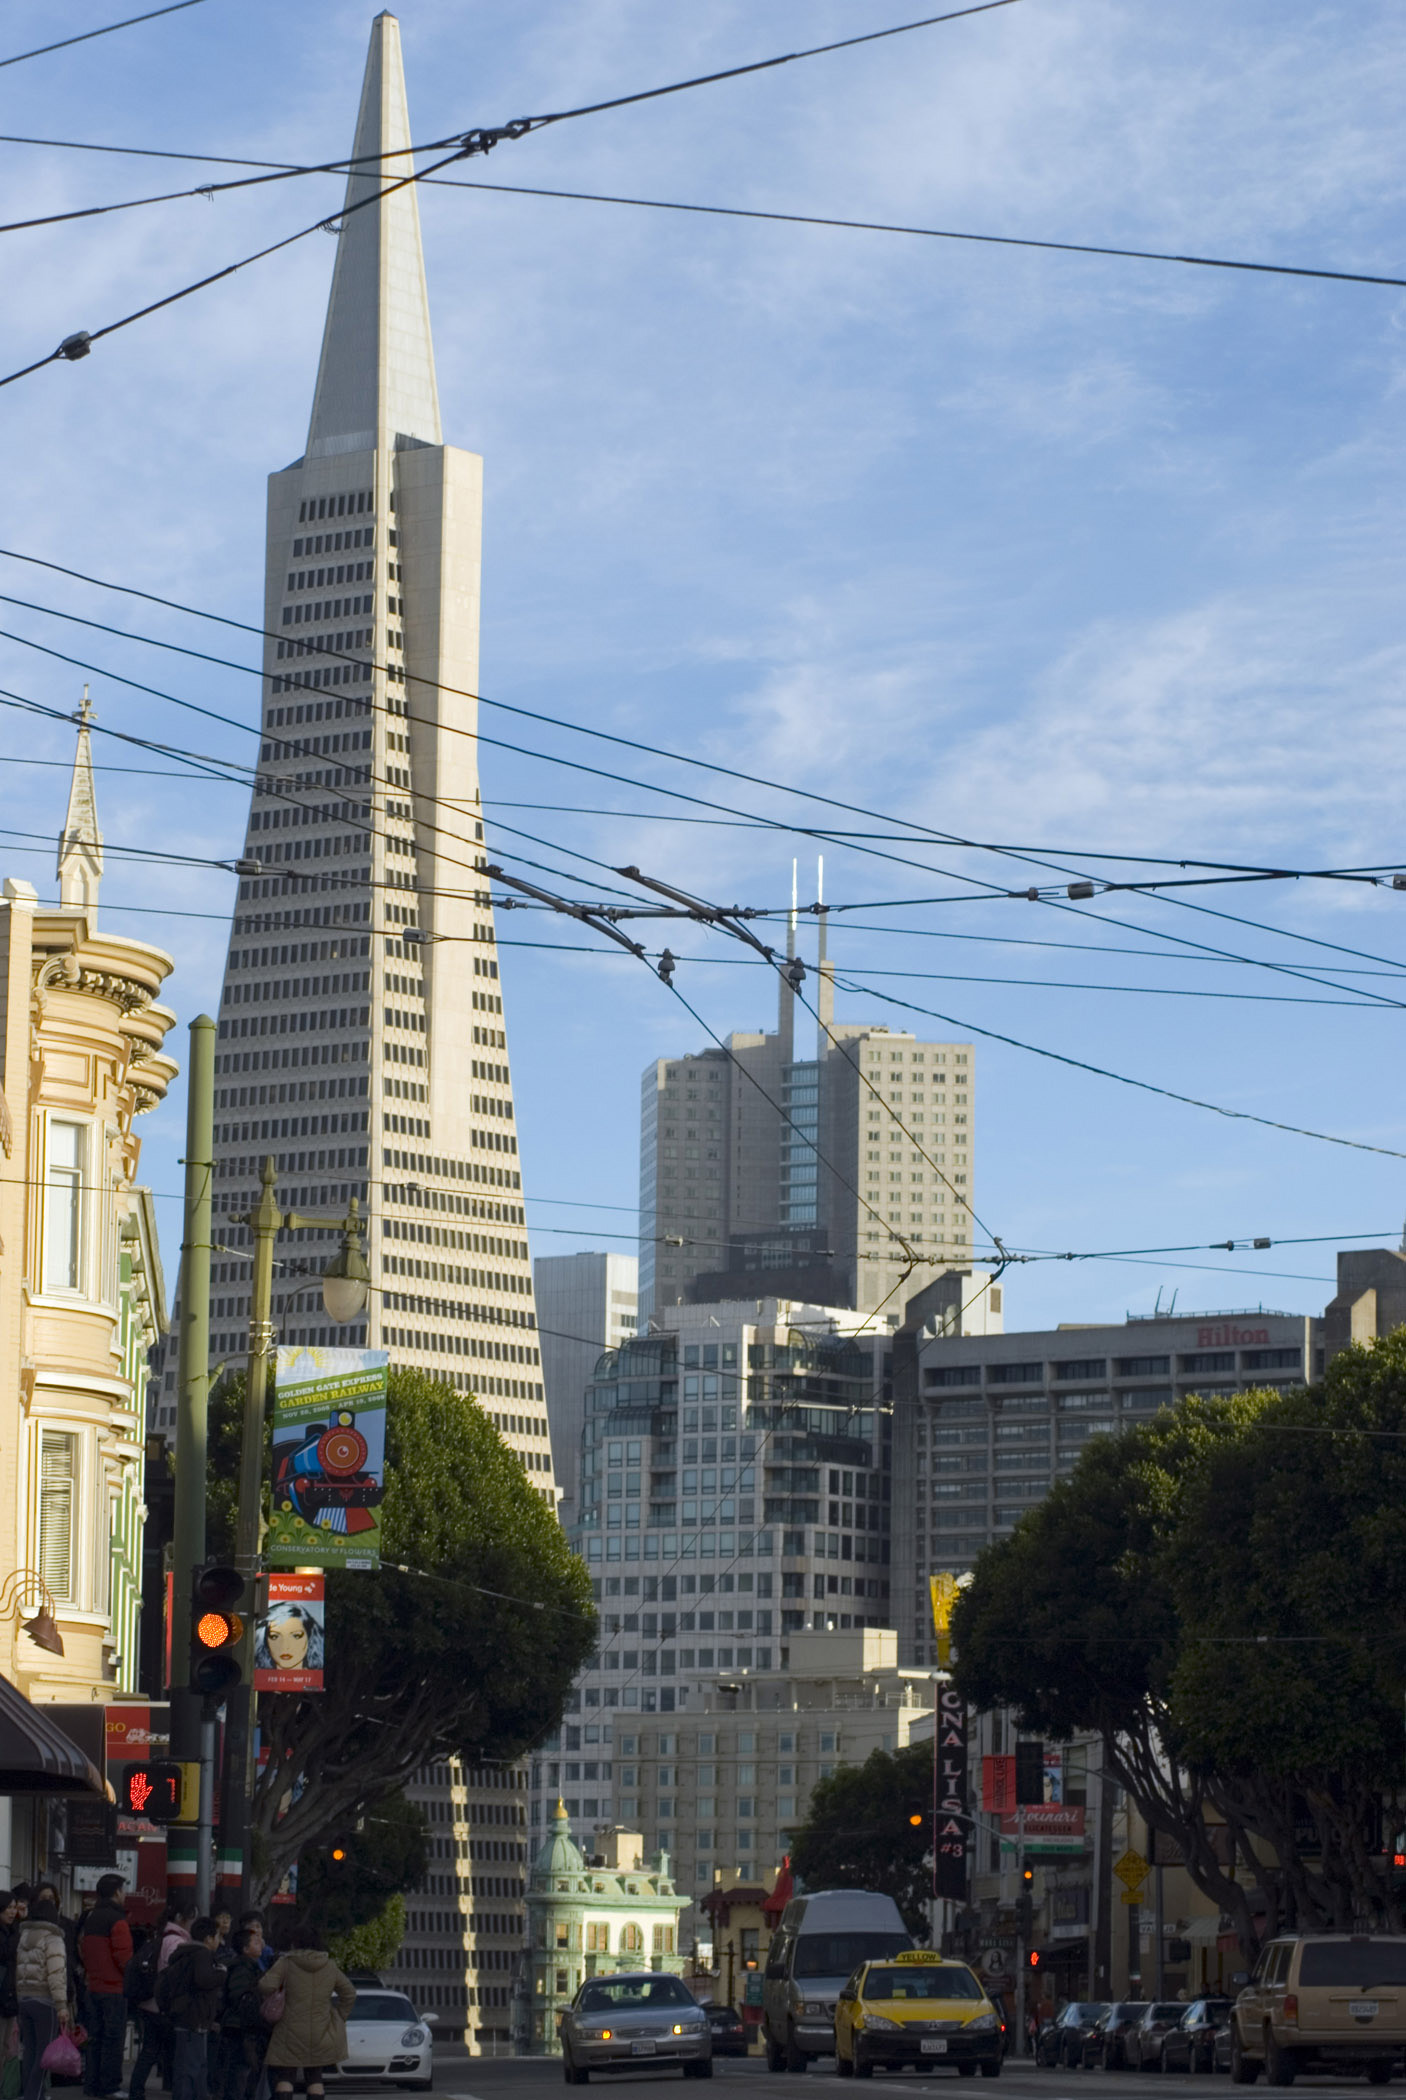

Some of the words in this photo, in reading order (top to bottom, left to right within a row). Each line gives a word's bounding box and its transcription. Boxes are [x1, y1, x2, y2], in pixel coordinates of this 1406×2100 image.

[1197, 1324, 1270, 1347] Hilton
[278, 1386, 314, 1399] GOLDEN
[316, 1381, 340, 1392] GATE
[342, 1373, 383, 1387] EXPRESS
[280, 1392, 328, 1409] GARDEN
[331, 1381, 384, 1399] RAILWAY
[270, 1544, 329, 1553] CONSERVATORY
[340, 1548, 376, 1557] FLOWERS
[278, 1583, 303, 1594] Young
[940, 1759, 964, 1836] LISA
[940, 1843, 963, 1857] #3
[901, 1953, 936, 1961] YELLOW
